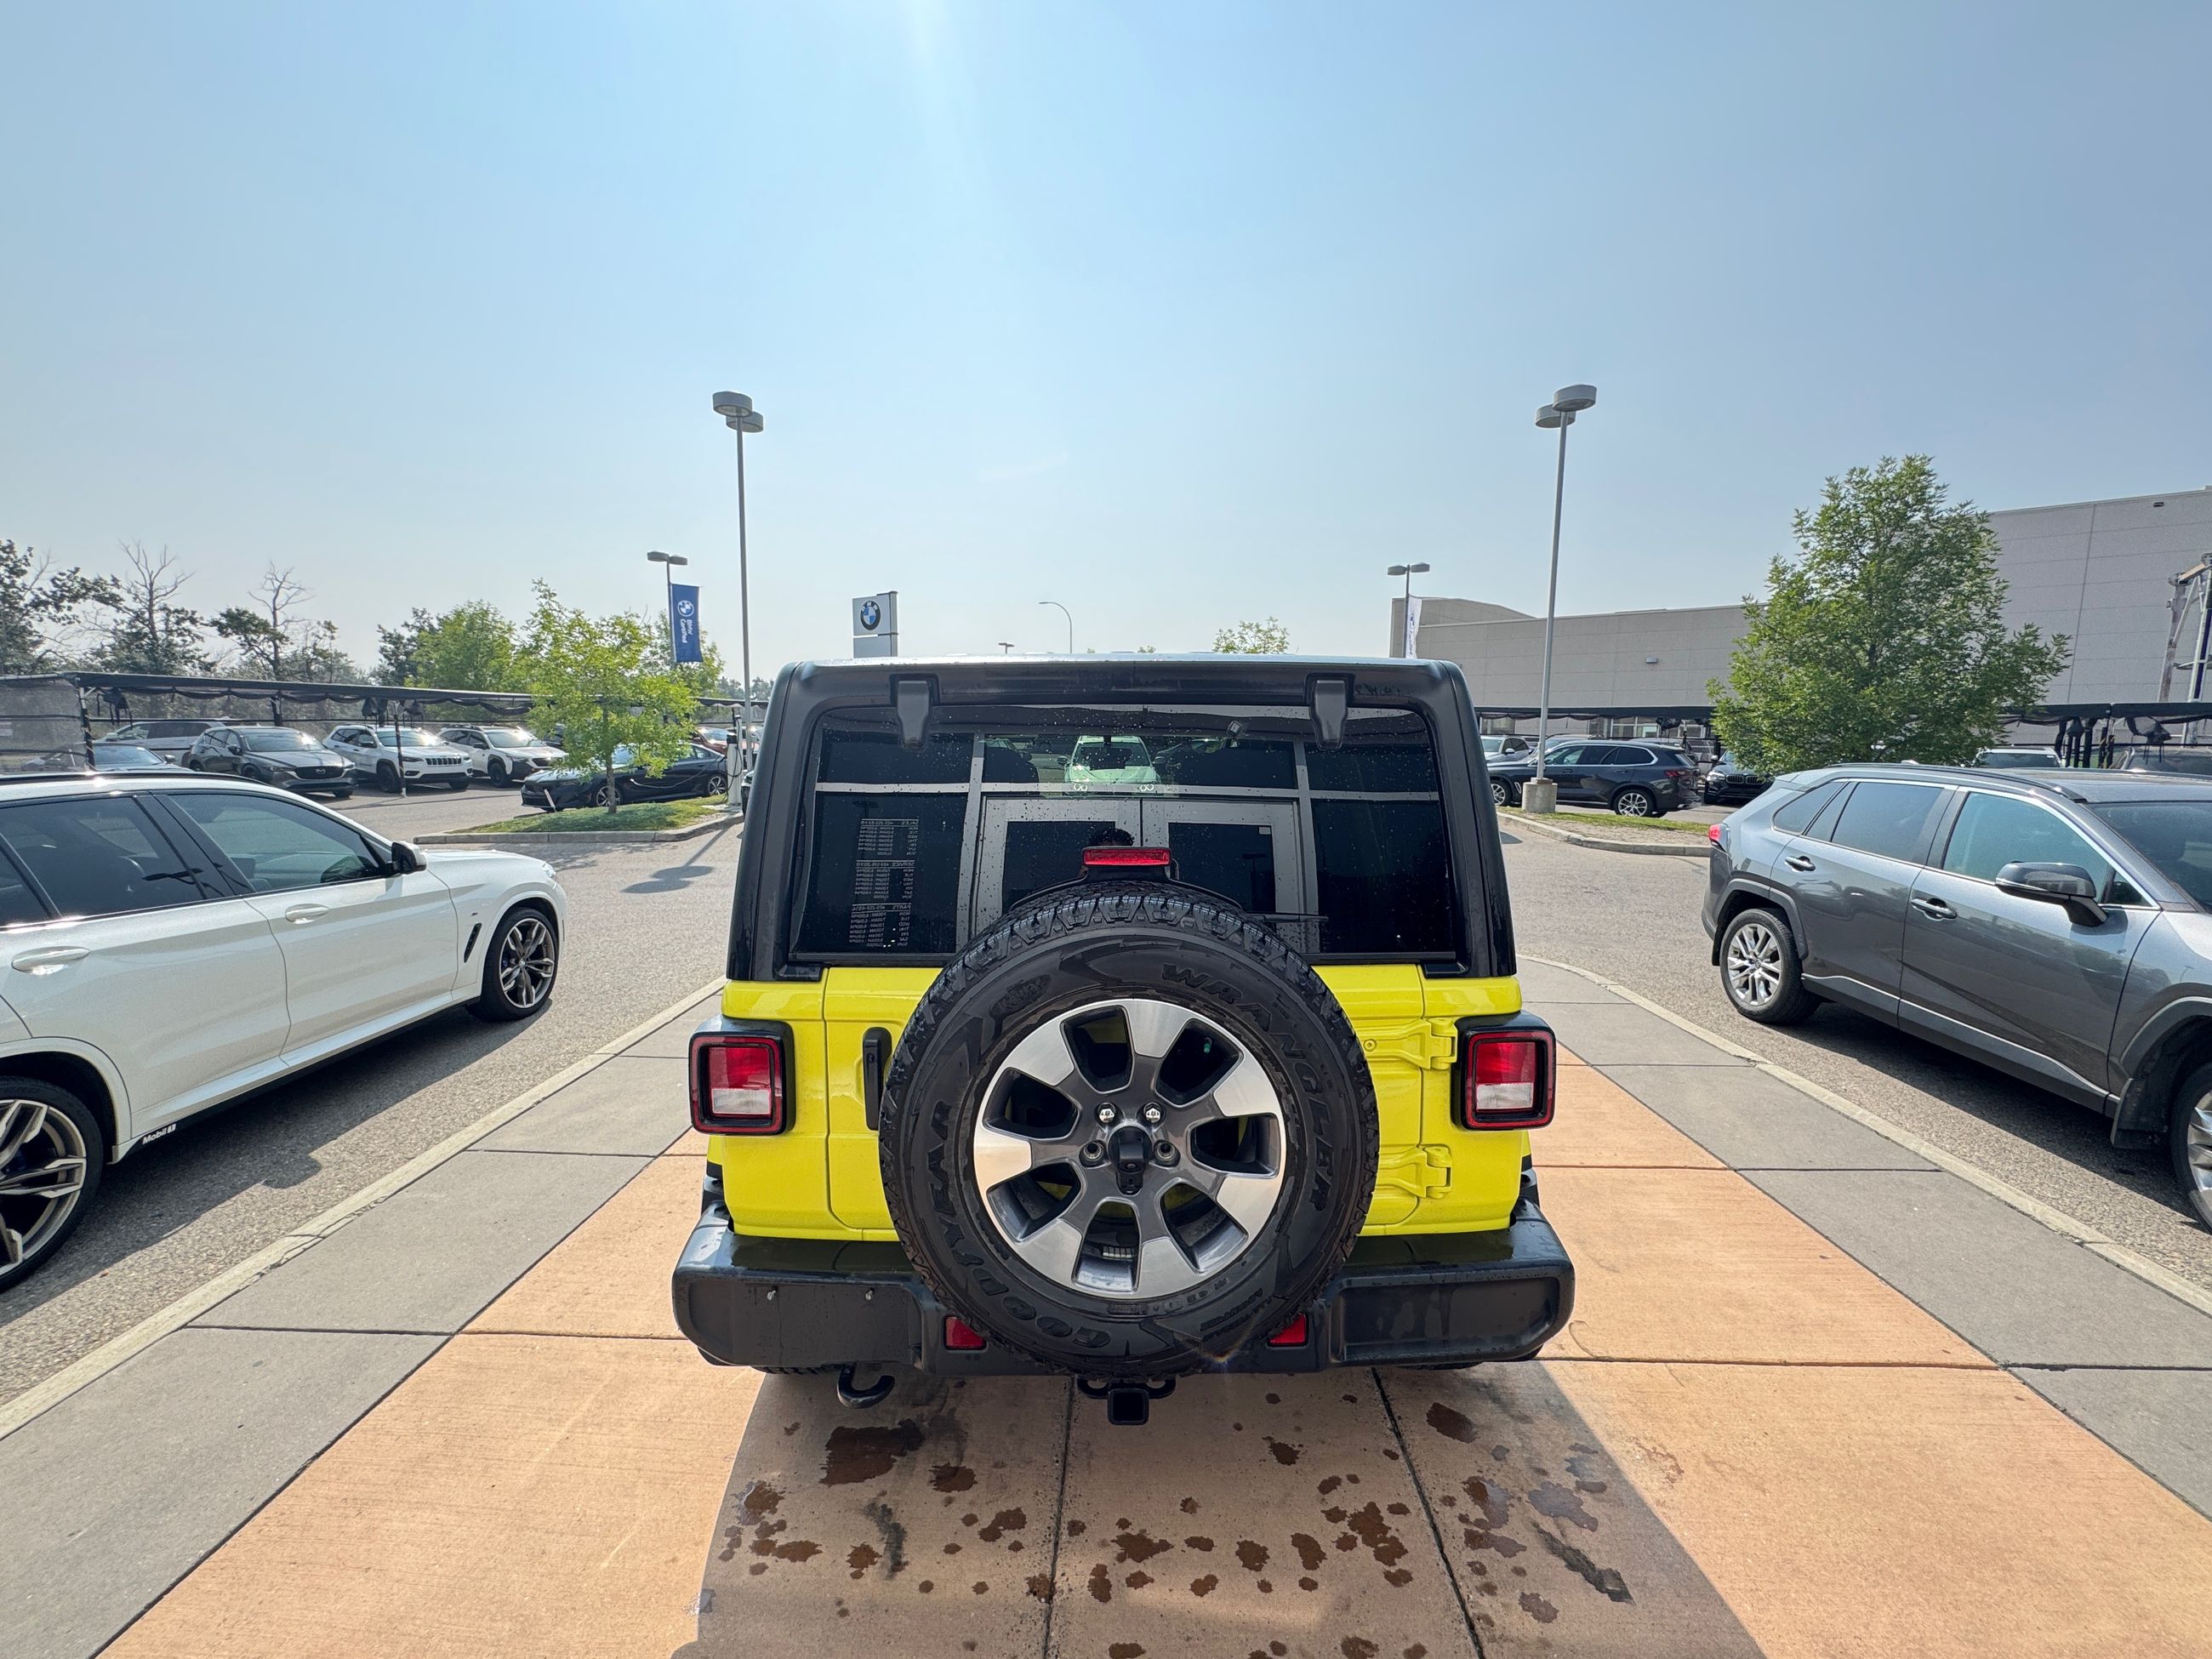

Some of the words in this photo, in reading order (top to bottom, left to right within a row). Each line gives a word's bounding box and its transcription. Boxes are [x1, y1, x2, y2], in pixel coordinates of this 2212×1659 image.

[861, 601, 878, 612] BMW
[142, 1127, 167, 1145] Mobil
[168, 1123, 177, 1134] 1
[1162, 963, 1334, 1211] WRANGLER
[926, 1101, 1111, 1348] GOODYEAR
